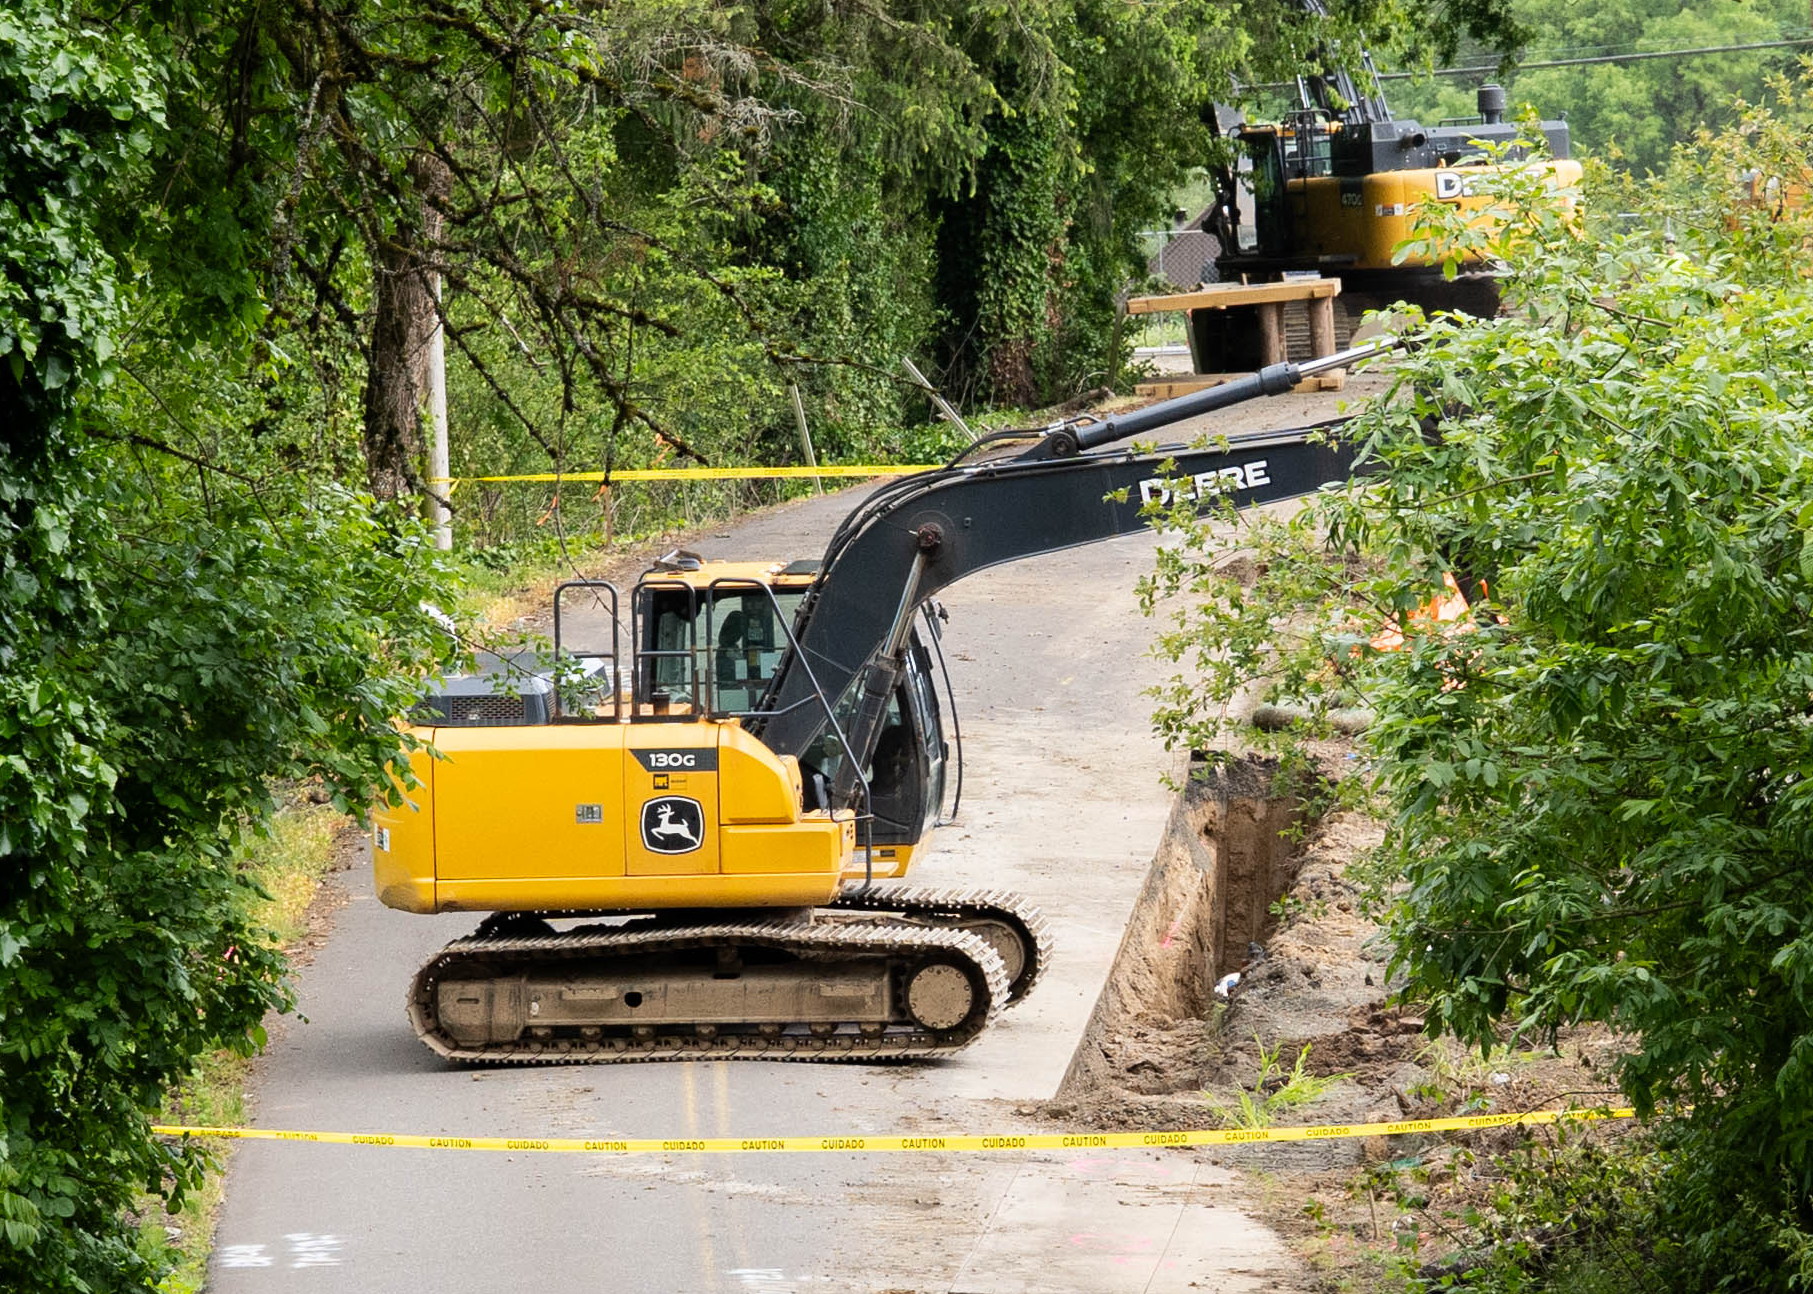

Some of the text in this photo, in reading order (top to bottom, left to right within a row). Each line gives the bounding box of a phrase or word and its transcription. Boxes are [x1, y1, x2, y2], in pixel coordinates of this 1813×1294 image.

[649, 753, 696, 767] 130G
[352, 1135, 395, 1145] CUIDADO
[429, 1138, 472, 1149] CAUTION
[507, 1140, 549, 1150] CUIDADO
[584, 1141, 628, 1151] CAUTION
[662, 1141, 706, 1151] CUIDADO
[741, 1140, 785, 1151] CAUTION
[821, 1139, 865, 1150] CUIDADO
[901, 1138, 946, 1149] CAUTION
[982, 1137, 1026, 1148] CUIDADO
[1062, 1136, 1107, 1147] CAUTION
[1143, 1133, 1188, 1145] CUIDADO
[1224, 1131, 1269, 1141] CAUTION
[1306, 1127, 1350, 1137] CUIDADO
[1387, 1122, 1432, 1132] CAUTION
[1468, 1116, 1512, 1126] CUIDADO
